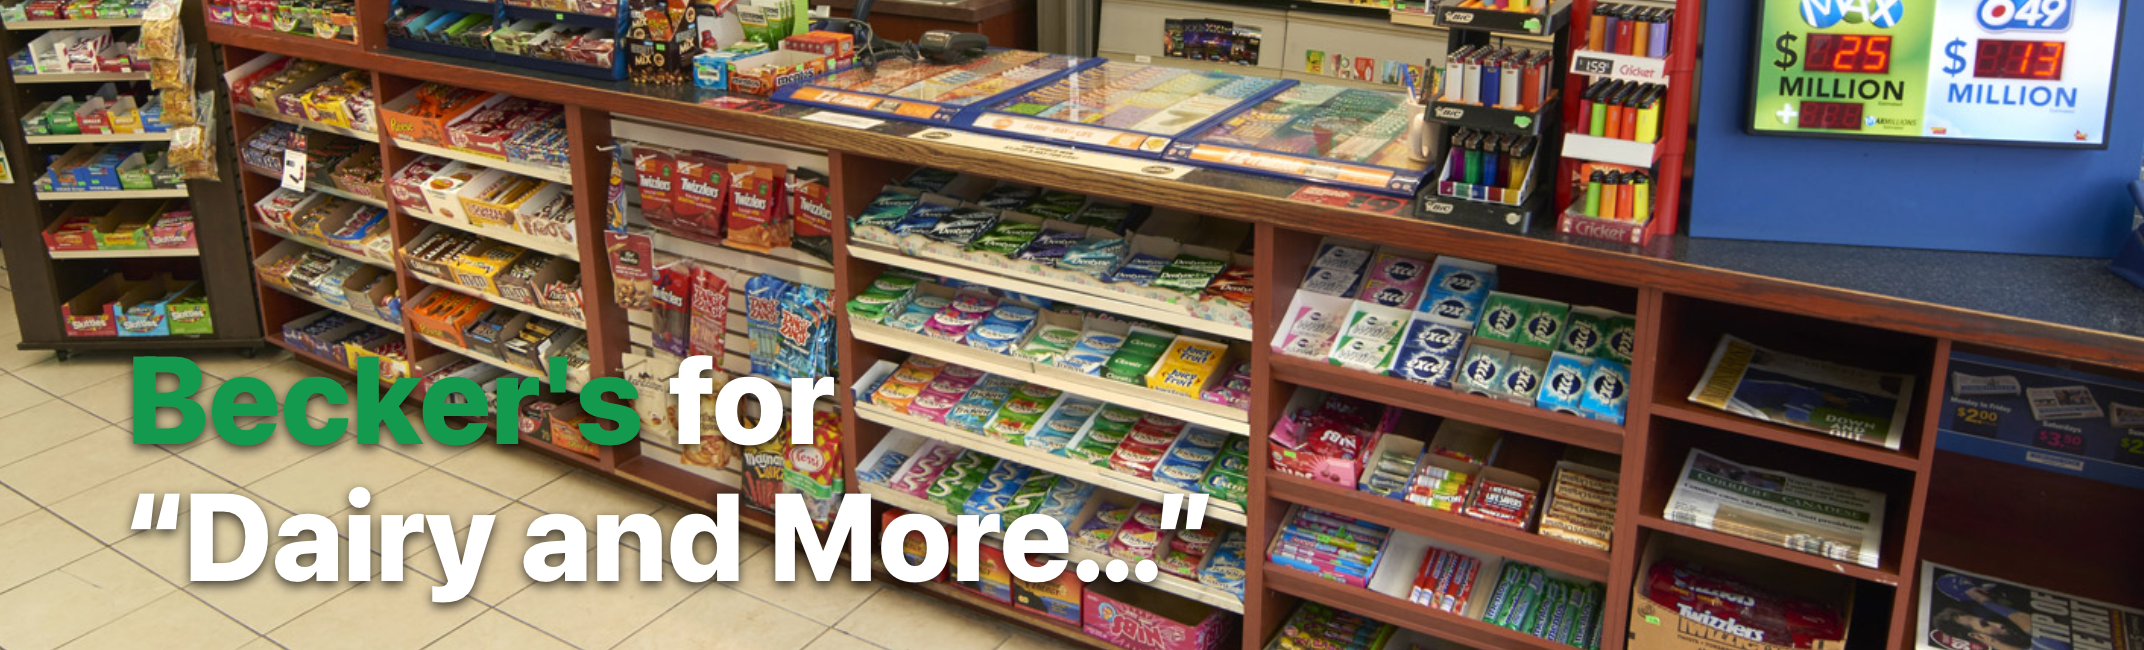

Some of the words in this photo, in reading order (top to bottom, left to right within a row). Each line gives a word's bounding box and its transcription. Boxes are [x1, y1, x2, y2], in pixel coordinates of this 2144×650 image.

[1774, 31, 1798, 70] $
[1833, 35, 1888, 71] 25
[1943, 37, 1967, 77] $
[2018, 42, 2061, 76] 13
[1619, 64, 1655, 78] Cricket
[1778, 76, 1905, 100] MILLION
[1947, 83, 2077, 107] MILLION
[639, 174, 671, 192] Twizzlers
[681, 177, 719, 199] Twizzlers
[734, 191, 766, 210] Twizzlers
[1575, 221, 1626, 239] Cricket
[1825, 414, 1876, 430] DOWN
[1782, 494, 1861, 522] CANADESE
[1676, 602, 1764, 643] Twizzlers
